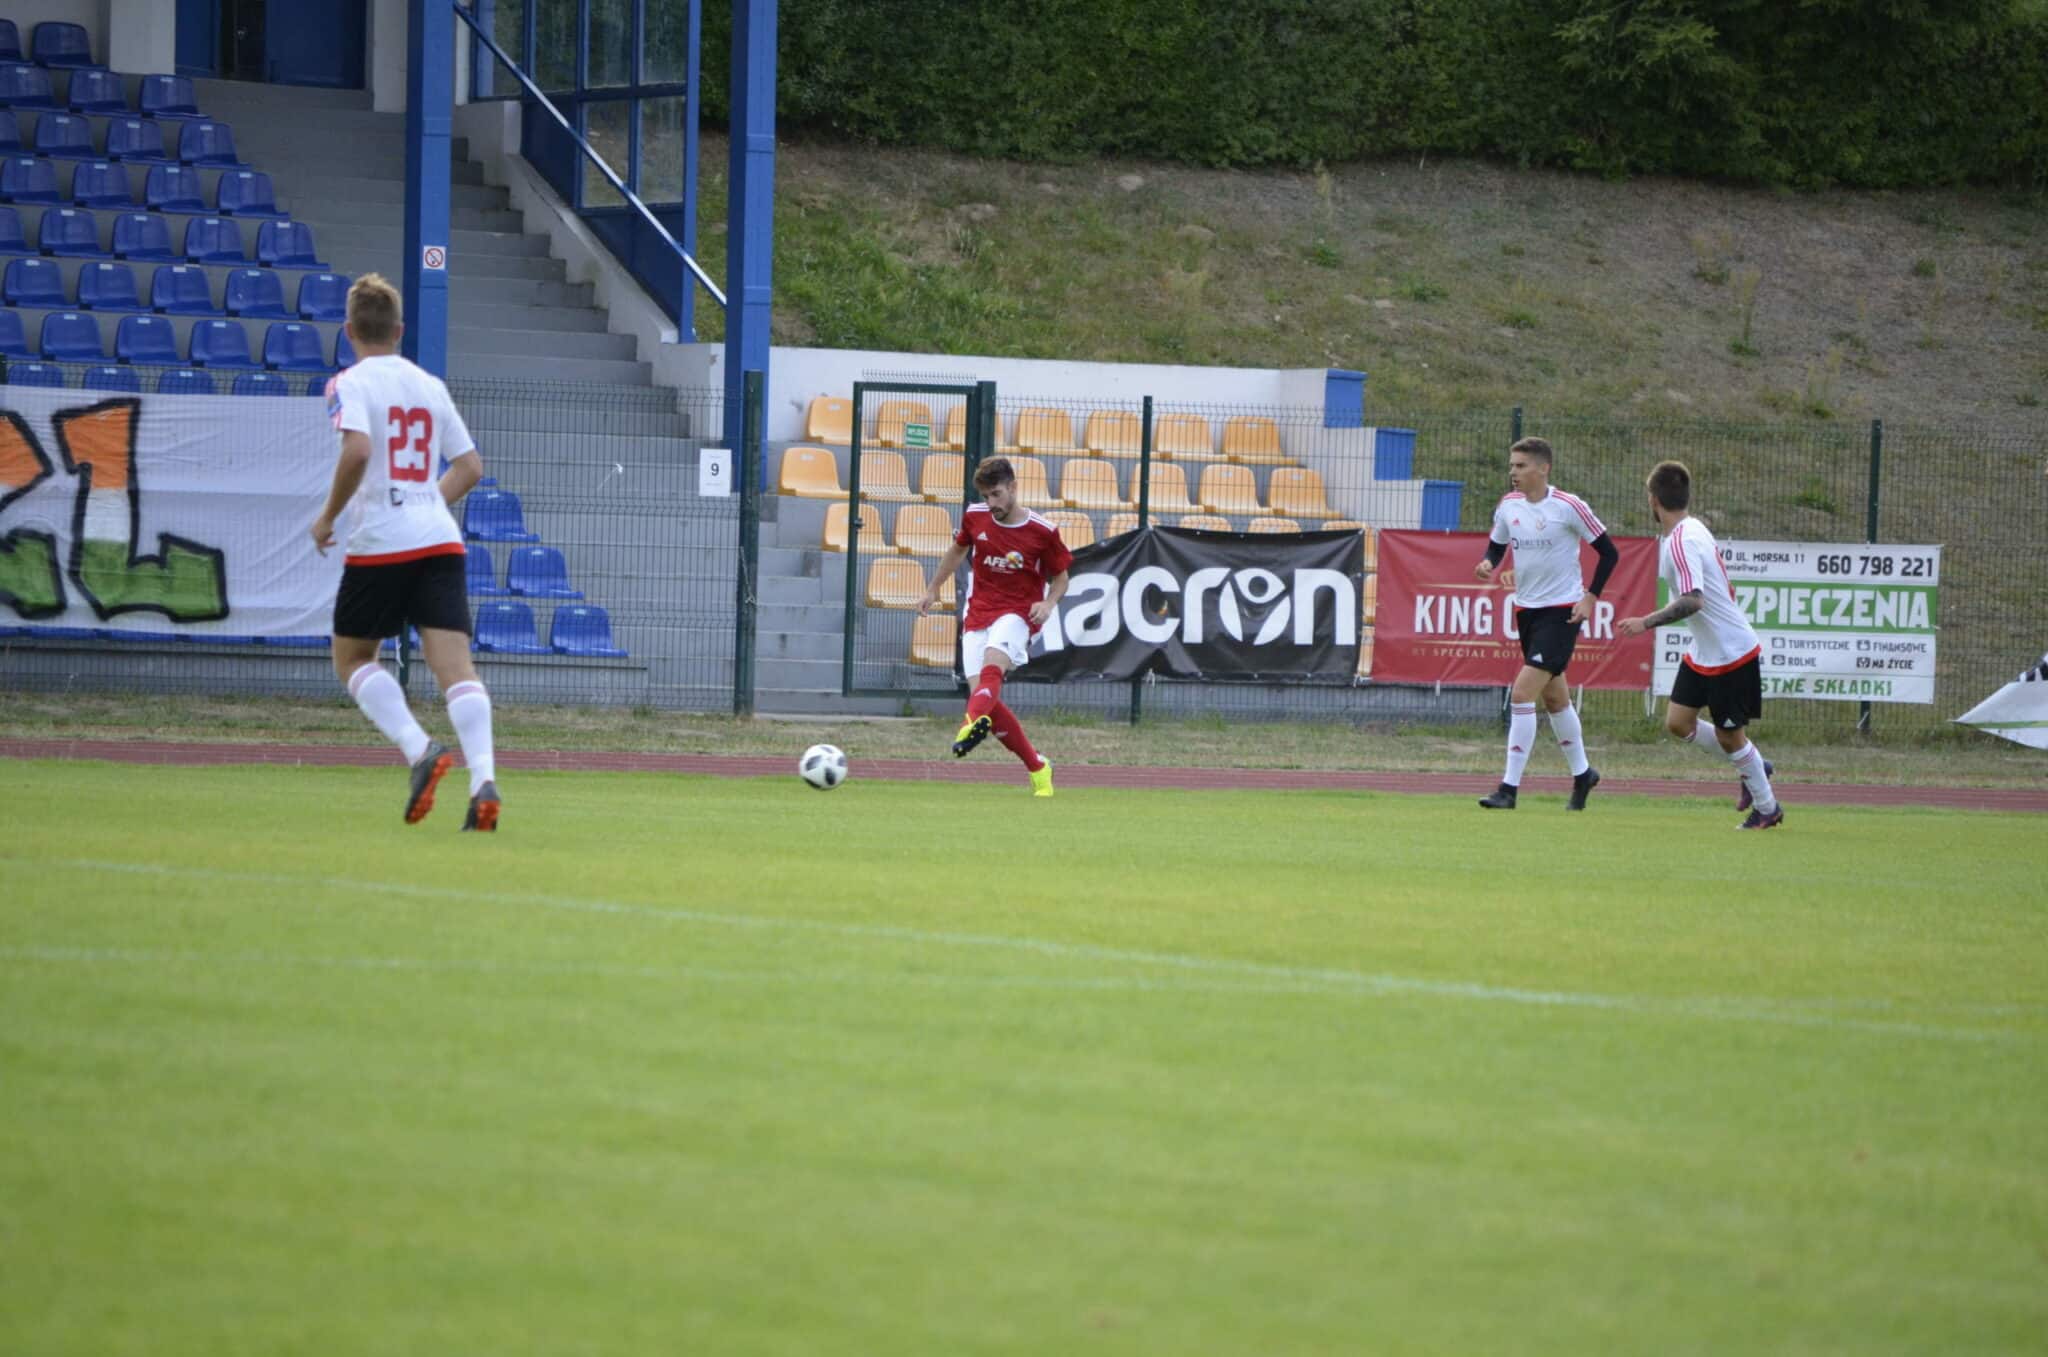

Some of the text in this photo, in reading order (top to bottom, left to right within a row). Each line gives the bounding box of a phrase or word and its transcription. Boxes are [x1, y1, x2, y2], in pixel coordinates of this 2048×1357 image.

[388, 405, 433, 482] 23
[711, 462, 719, 477] 9
[1753, 552, 1790, 562] MORSKA
[1817, 555, 1933, 577] 660 798 221
[1414, 594, 1493, 635] KING
[1736, 586, 1931, 629] ZPIECZENIA
[1432, 647, 1486, 658] SPECIAL
[1493, 649, 1525, 659] ROYA
[1760, 677, 1806, 693] STNE
